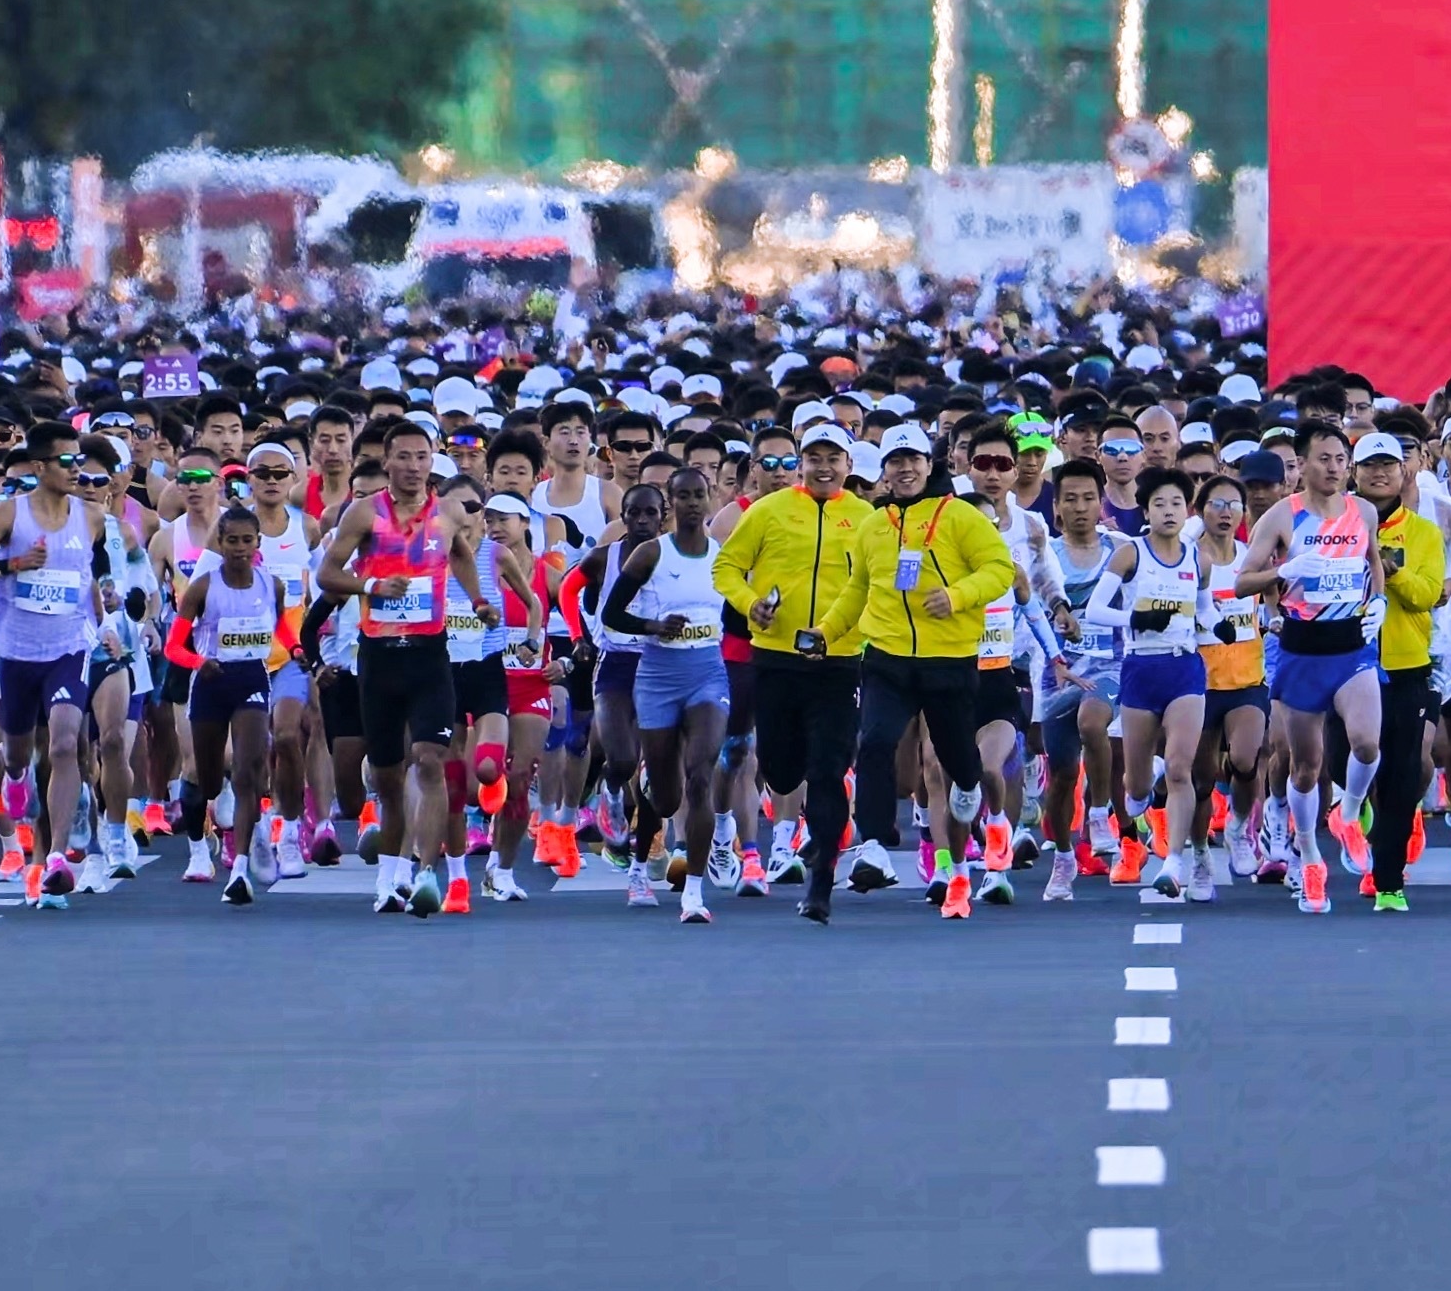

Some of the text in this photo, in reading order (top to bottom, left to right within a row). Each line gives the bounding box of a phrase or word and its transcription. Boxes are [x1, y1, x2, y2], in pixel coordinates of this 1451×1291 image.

[144, 373, 192, 392] 2:55
[1304, 535, 1358, 546] BROOKS
[1318, 573, 1353, 588] A0248
[28, 585, 66, 600] A0024
[221, 631, 272, 648] GENANEH
